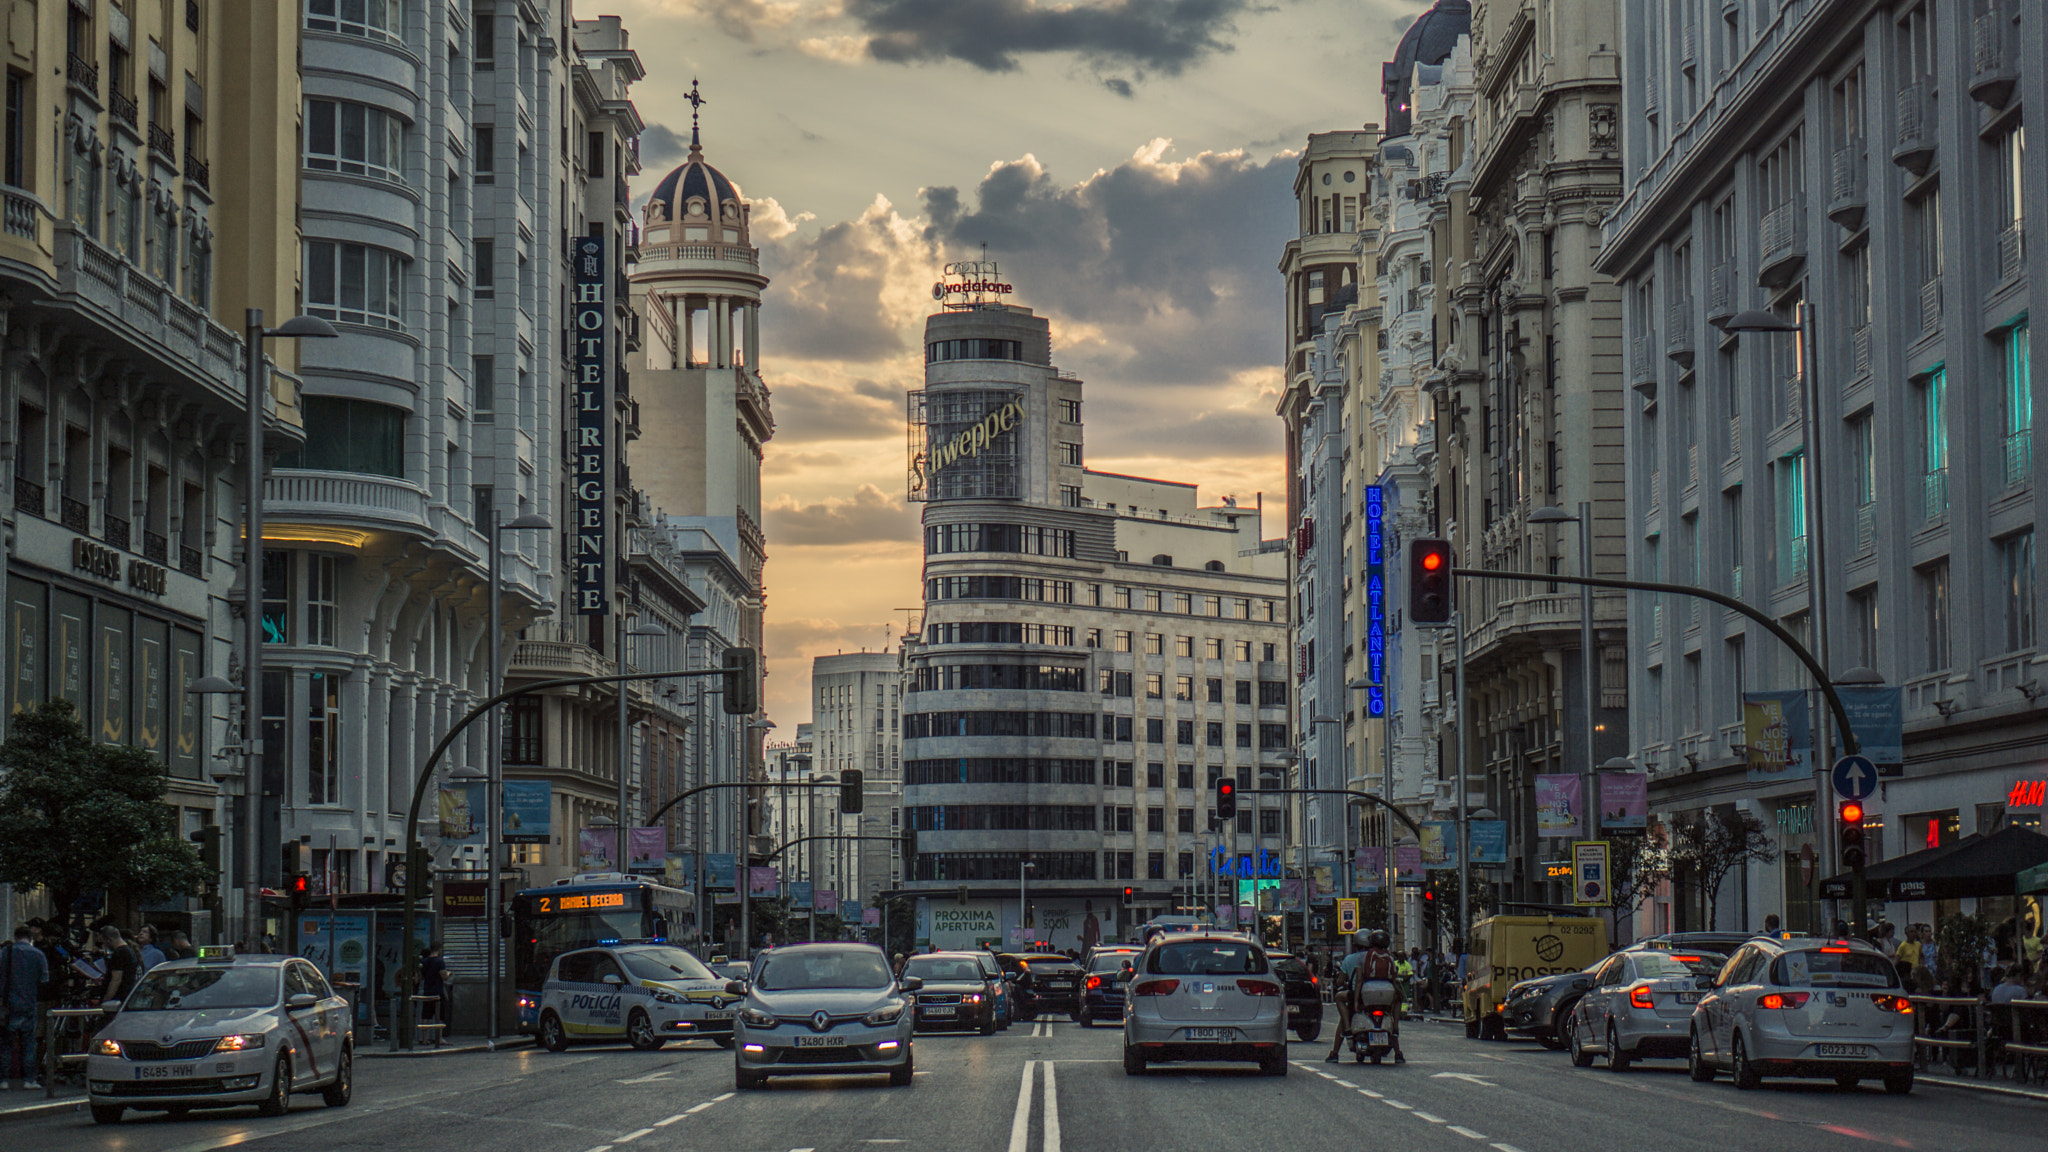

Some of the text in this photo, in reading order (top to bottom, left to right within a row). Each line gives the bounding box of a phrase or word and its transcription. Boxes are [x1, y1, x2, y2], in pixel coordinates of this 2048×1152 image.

[944, 262, 998, 275] CAPITOL
[945, 279, 1012, 294] vodafone
[578, 283, 603, 610] HOTEL REGENTE
[912, 394, 1026, 492] Schweppes
[73, 538, 120, 581] ESPASA
[1367, 488, 1384, 714] HOTEL ATLANTICO
[1761, 704, 1777, 716] VE
[1762, 727, 1788, 740] NOS
[1754, 740, 1789, 752] DE LA
[1549, 800, 1568, 808] NOS
[1776, 804, 1815, 835] PRIMARK
[1900, 881, 1925, 893] pans
[457, 895, 486, 903] TABAC
[540, 897, 551, 912] 2
[935, 908, 994, 921] PRÓXIMA
[935, 921, 995, 932] APERTURA
[1043, 917, 1069, 930] SOON
[1561, 926, 1595, 935] 02 0292
[1494, 966, 1585, 982] PROSE
[1183, 983, 1190, 993] V
[1812, 992, 1819, 1002] X
[1193, 1028, 1233, 1037] 1800 HRN
[801, 1036, 845, 1046] 3480 HXR
[1821, 1045, 1867, 1055] 6023 JLZ
[142, 1067, 193, 1077] 6485 HVH
